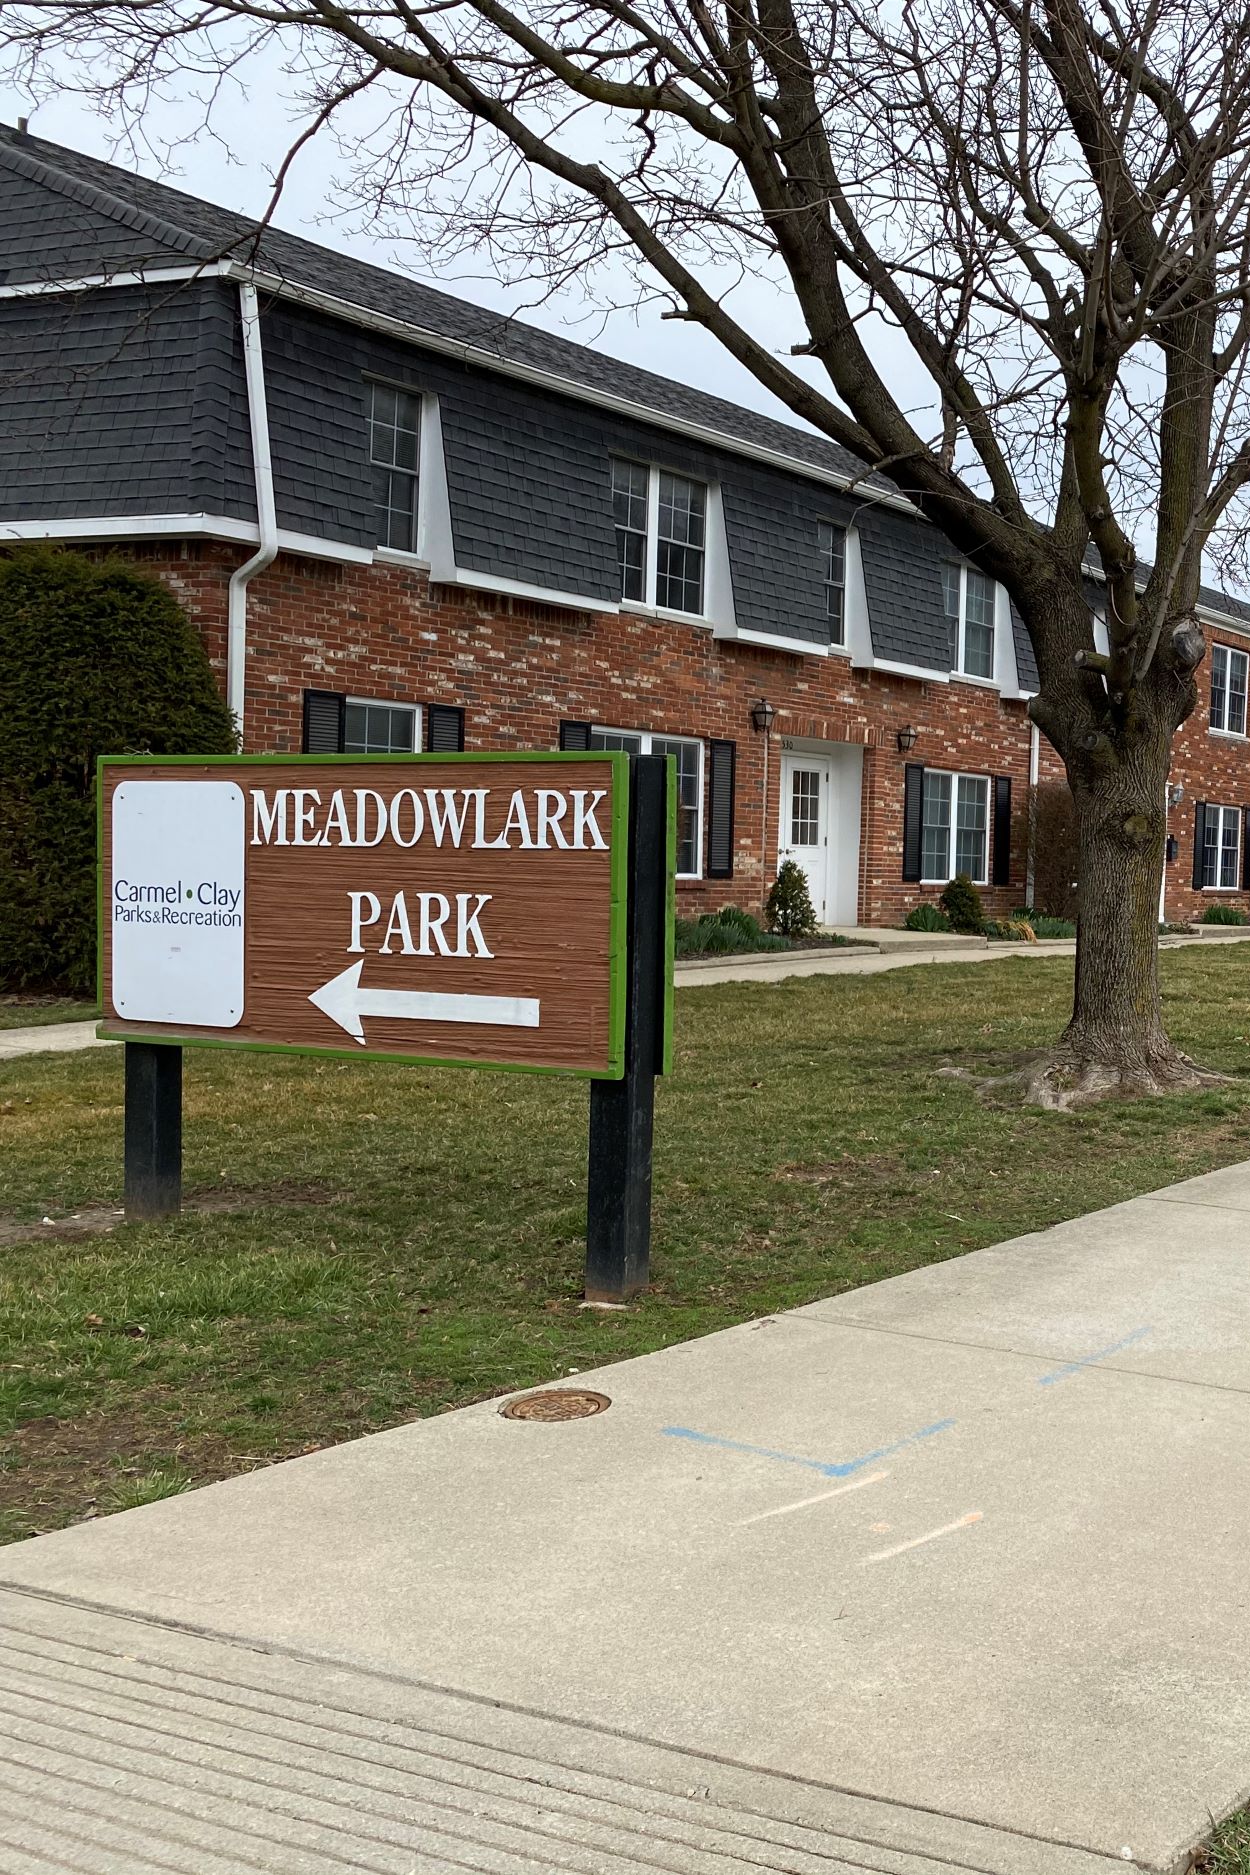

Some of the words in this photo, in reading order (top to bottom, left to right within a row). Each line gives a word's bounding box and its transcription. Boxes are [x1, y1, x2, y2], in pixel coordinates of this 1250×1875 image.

[249, 788, 611, 851] MEADOWLARK
[114, 879, 182, 904] Carmel
[197, 881, 241, 913] Clay
[114, 904, 242, 928] Parks&Recreation
[346, 890, 495, 960] PARK
